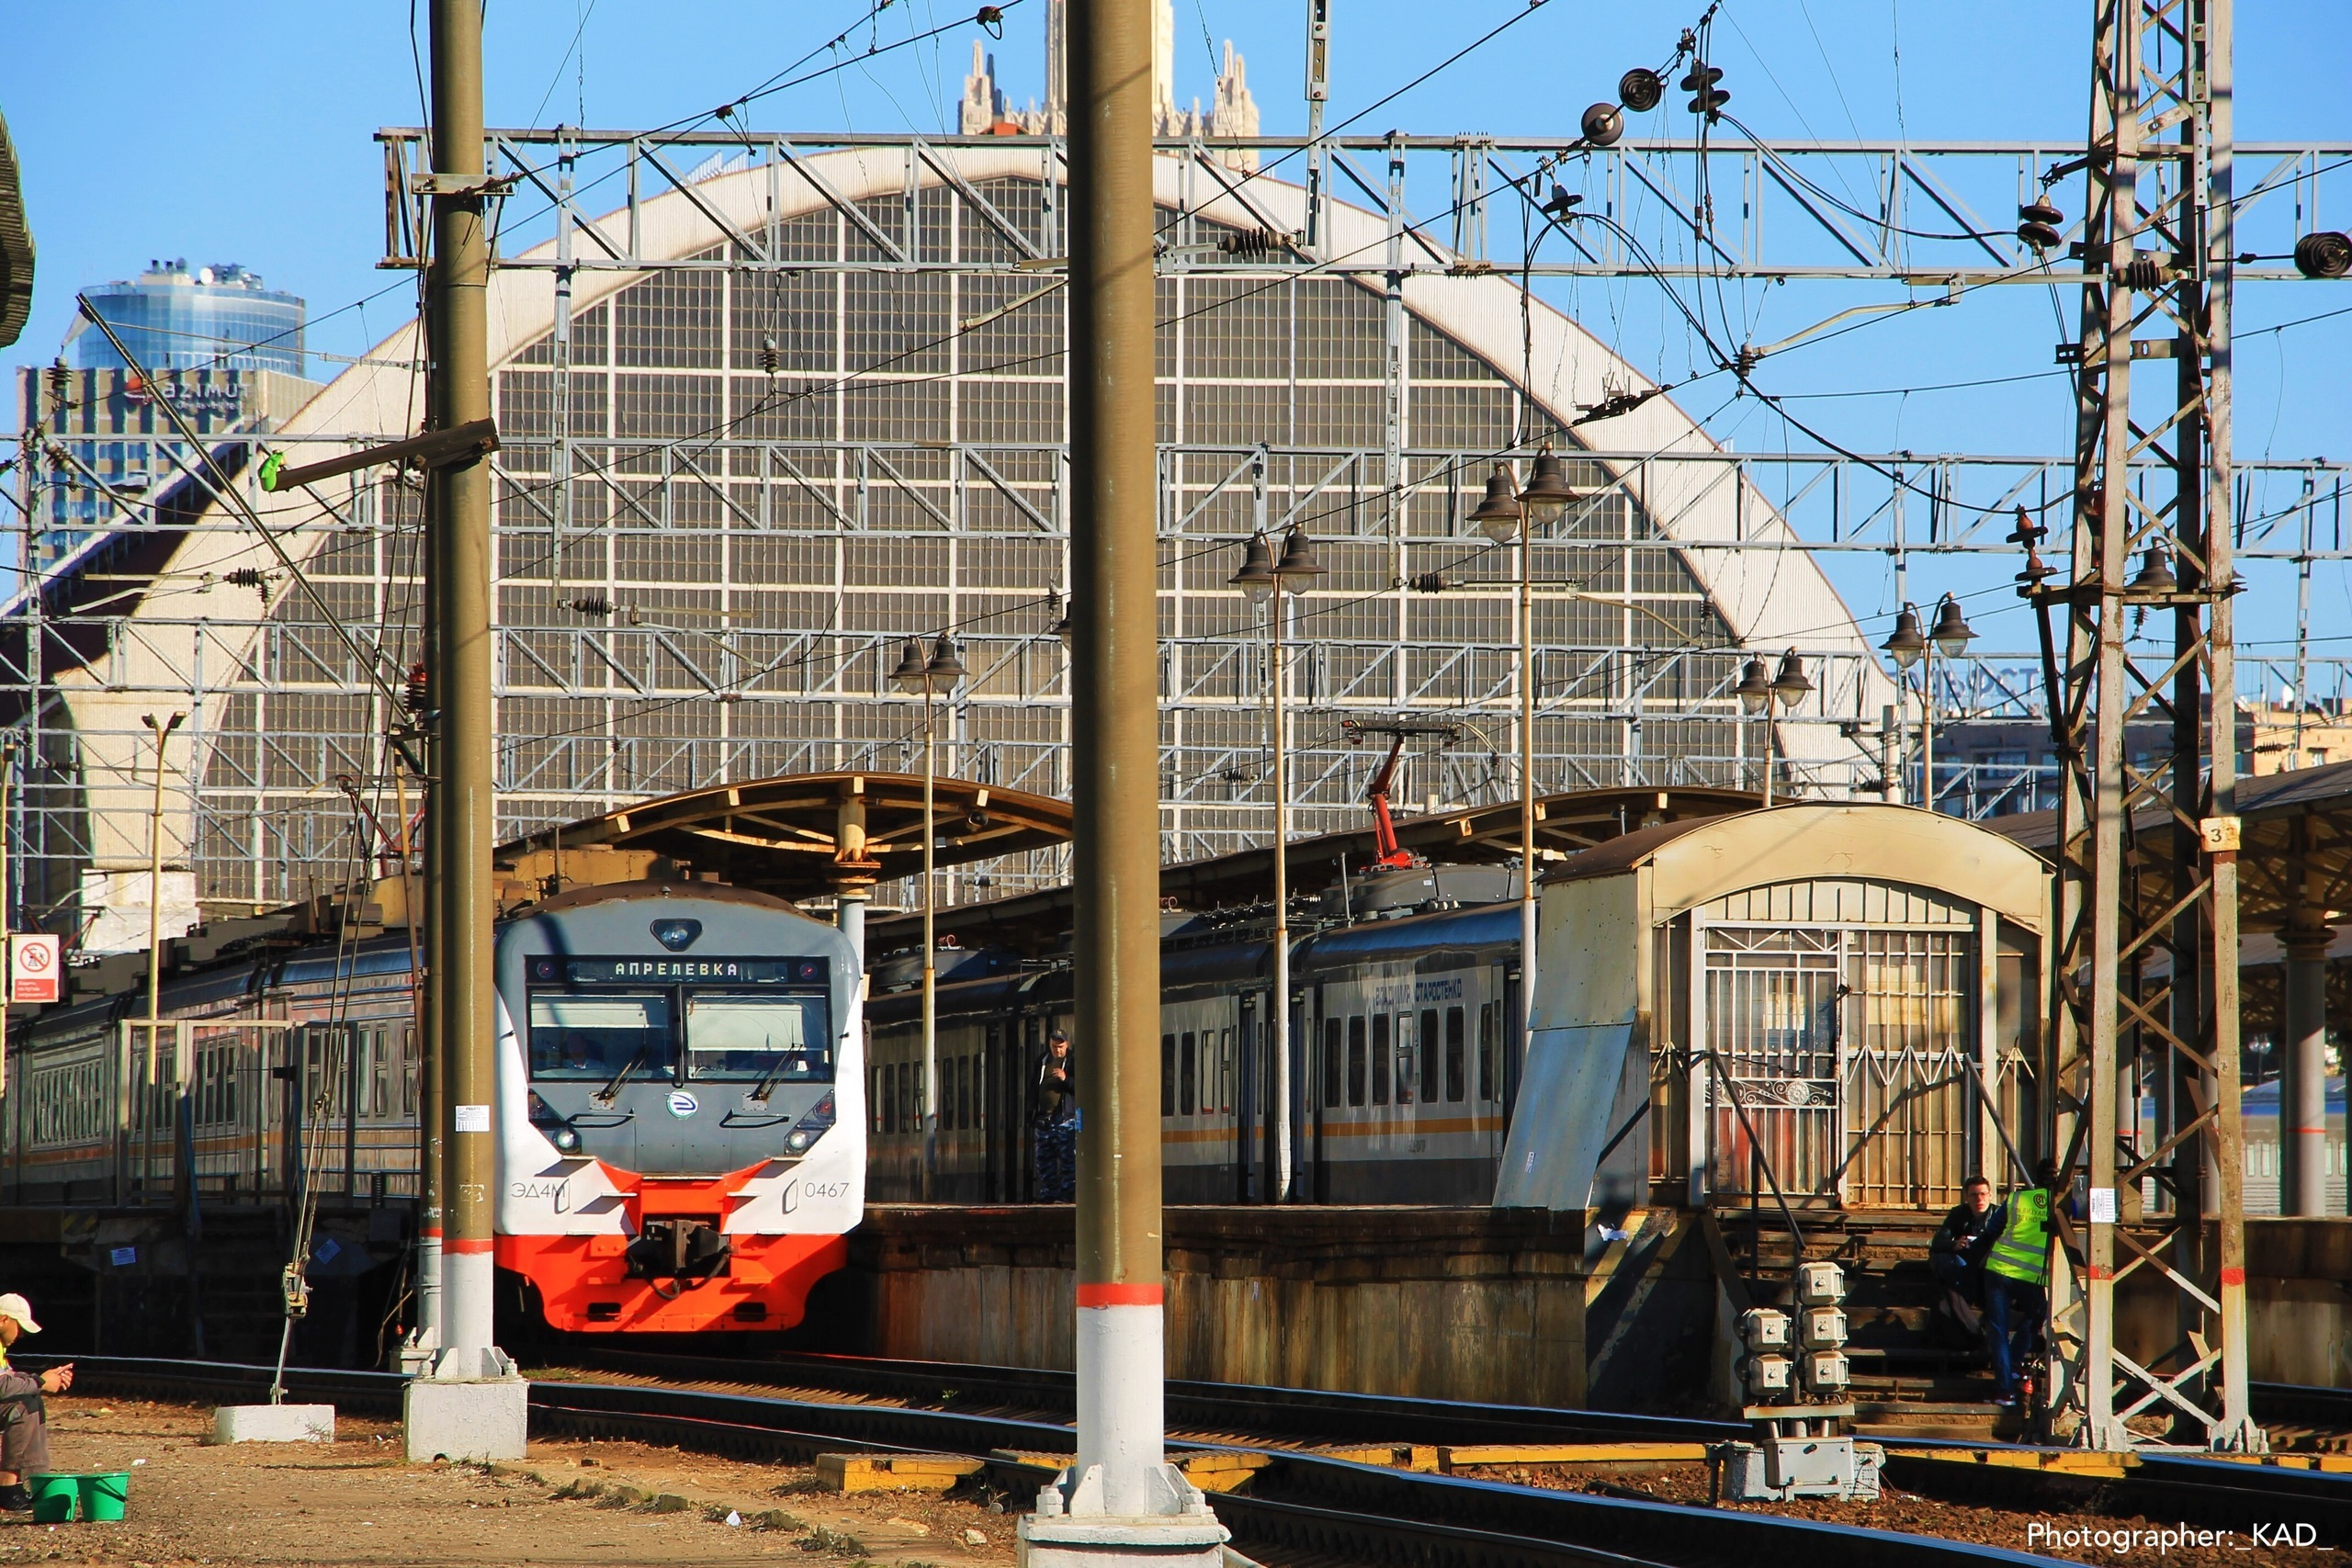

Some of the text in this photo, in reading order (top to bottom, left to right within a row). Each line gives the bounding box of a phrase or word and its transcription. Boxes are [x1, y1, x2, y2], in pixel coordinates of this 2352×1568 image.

[615, 963, 738, 976] АПРЕЛЕВКА
[1415, 978, 1463, 1003] СТАРОСТЕНКО
[511, 1182, 566, 1199] ЭД4М
[805, 1182, 850, 1198] 0467
